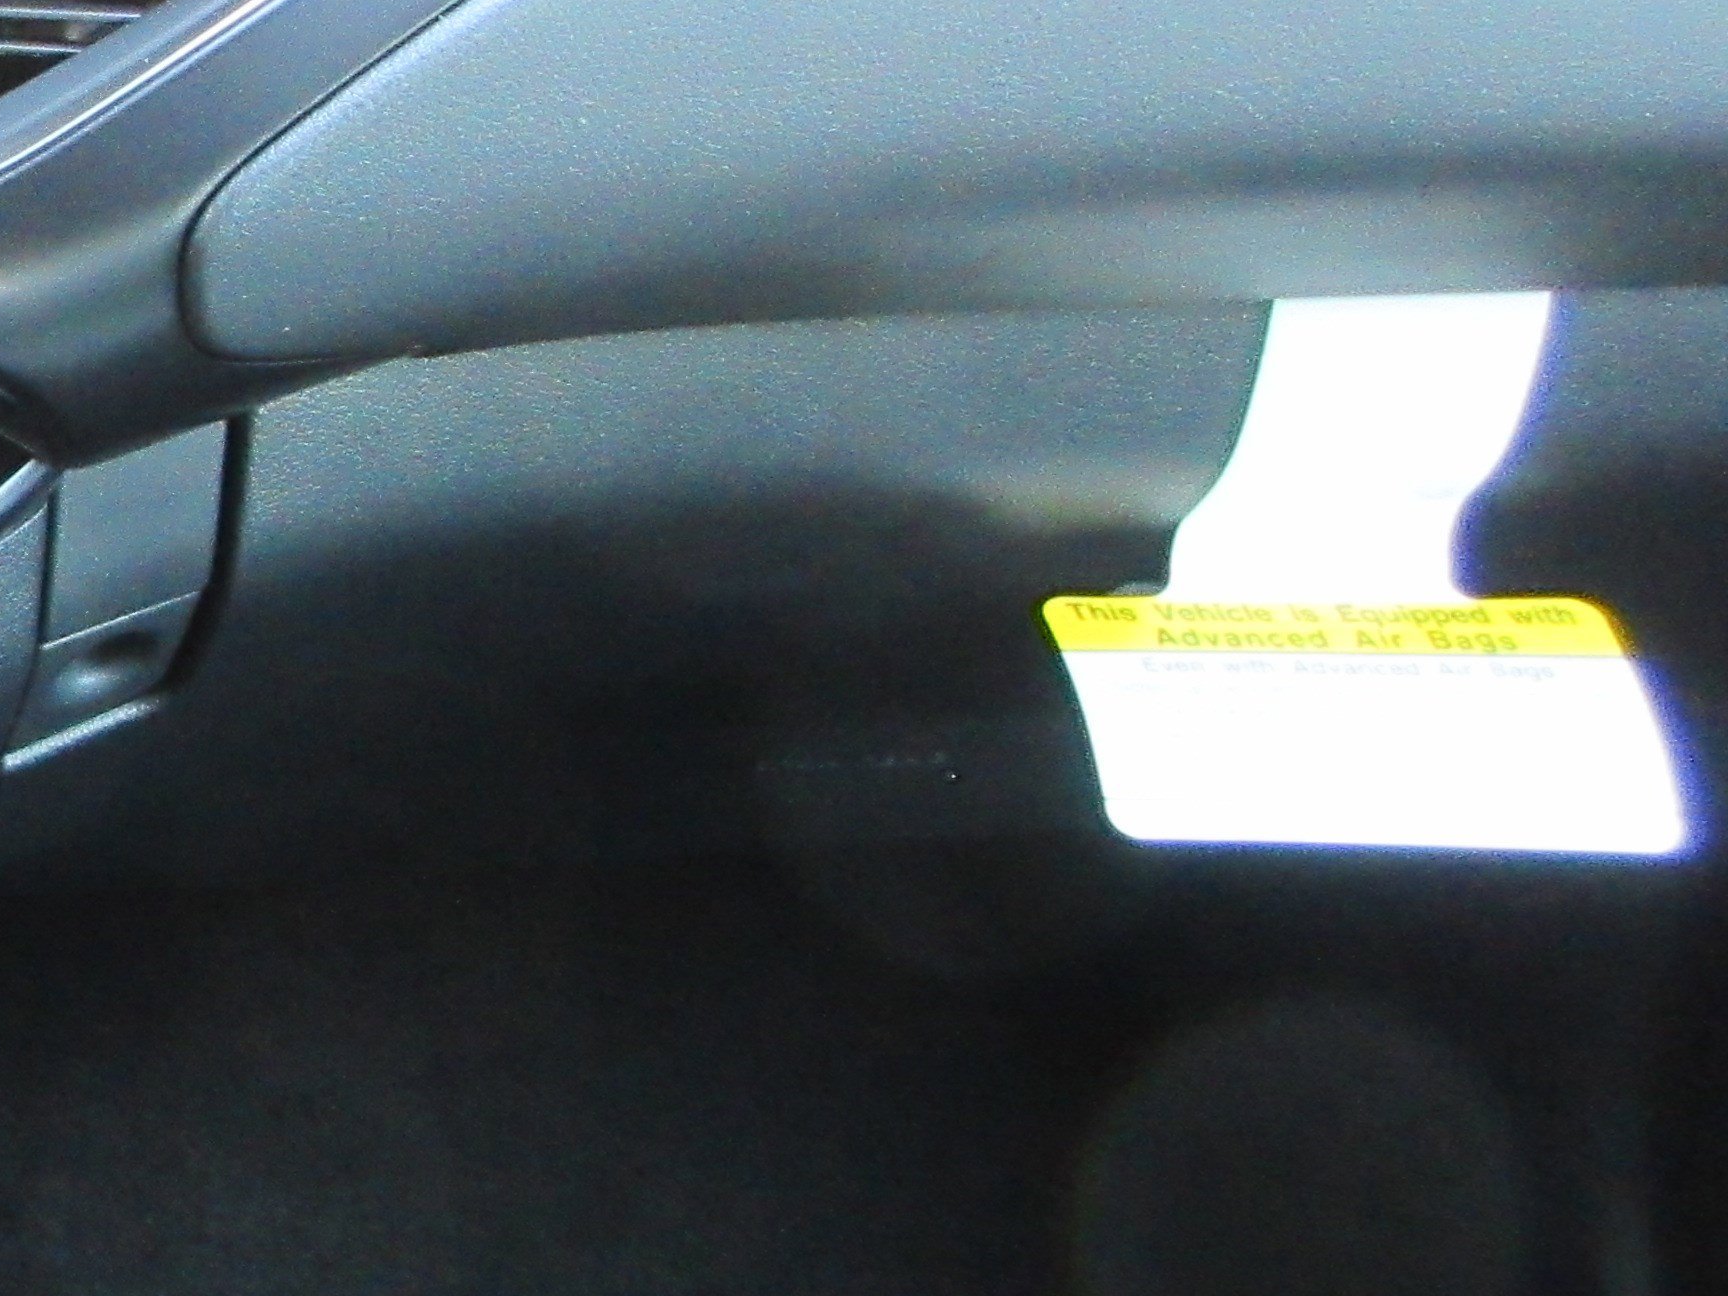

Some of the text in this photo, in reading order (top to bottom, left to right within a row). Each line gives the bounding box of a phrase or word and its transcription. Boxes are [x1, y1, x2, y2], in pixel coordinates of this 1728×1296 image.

[1065, 601, 1139, 621] This
[1152, 601, 1273, 623] Vehicle
[1335, 603, 1491, 628] Equipped
[1510, 604, 1578, 625] with
[1156, 627, 1519, 655] Advanced Air Bags
